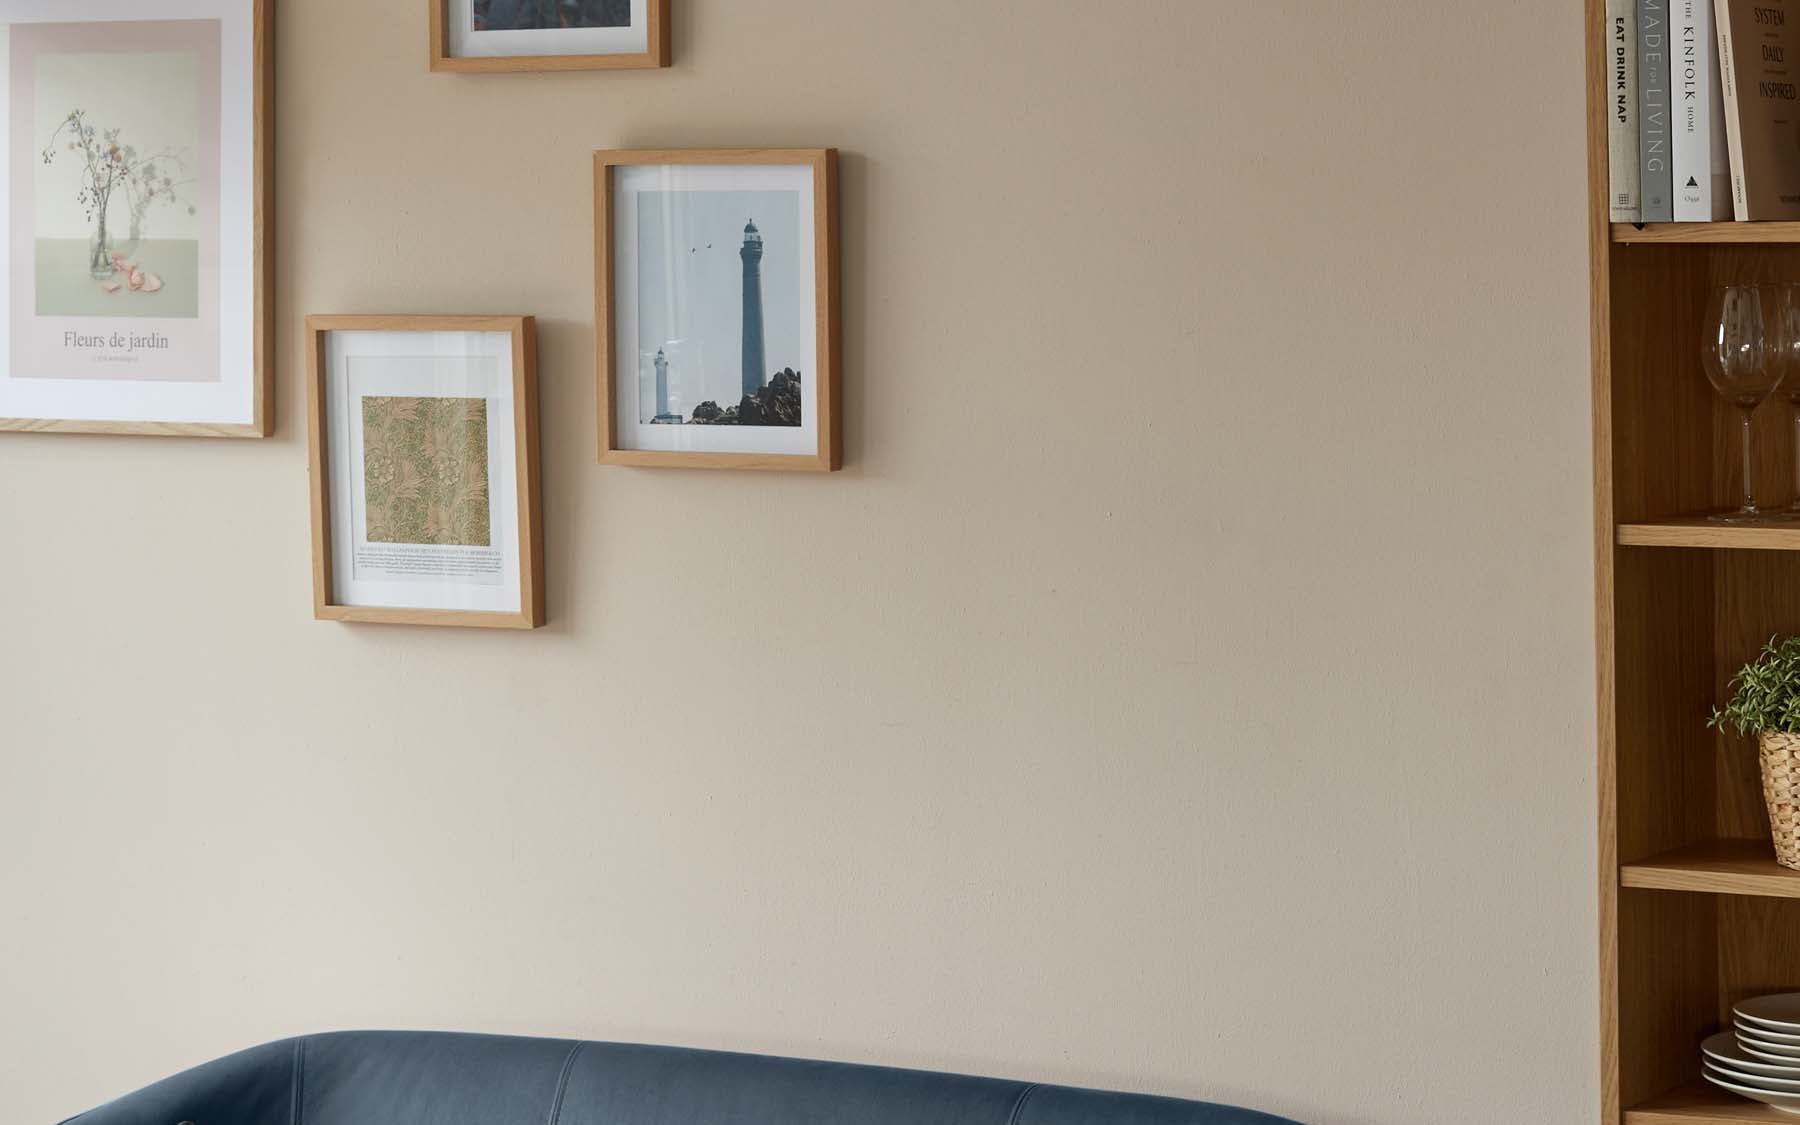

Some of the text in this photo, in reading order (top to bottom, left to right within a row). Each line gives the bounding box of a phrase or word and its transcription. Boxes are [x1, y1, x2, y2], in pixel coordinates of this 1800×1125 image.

[1684, 2, 1692, 19] THE
[1754, 7, 1785, 26] SYSTEM
[1645, 0, 1662, 63] MADE
[1683, 26, 1696, 100] KINFOLK
[1761, 44, 1784, 62] DAILY
[1616, 17, 1627, 123] EAT DRINK NAP
[1760, 80, 1796, 100] INSPIRED
[1646, 88, 1663, 171] LIVING
[64, 331, 168, 352] Fleurs de jardin
